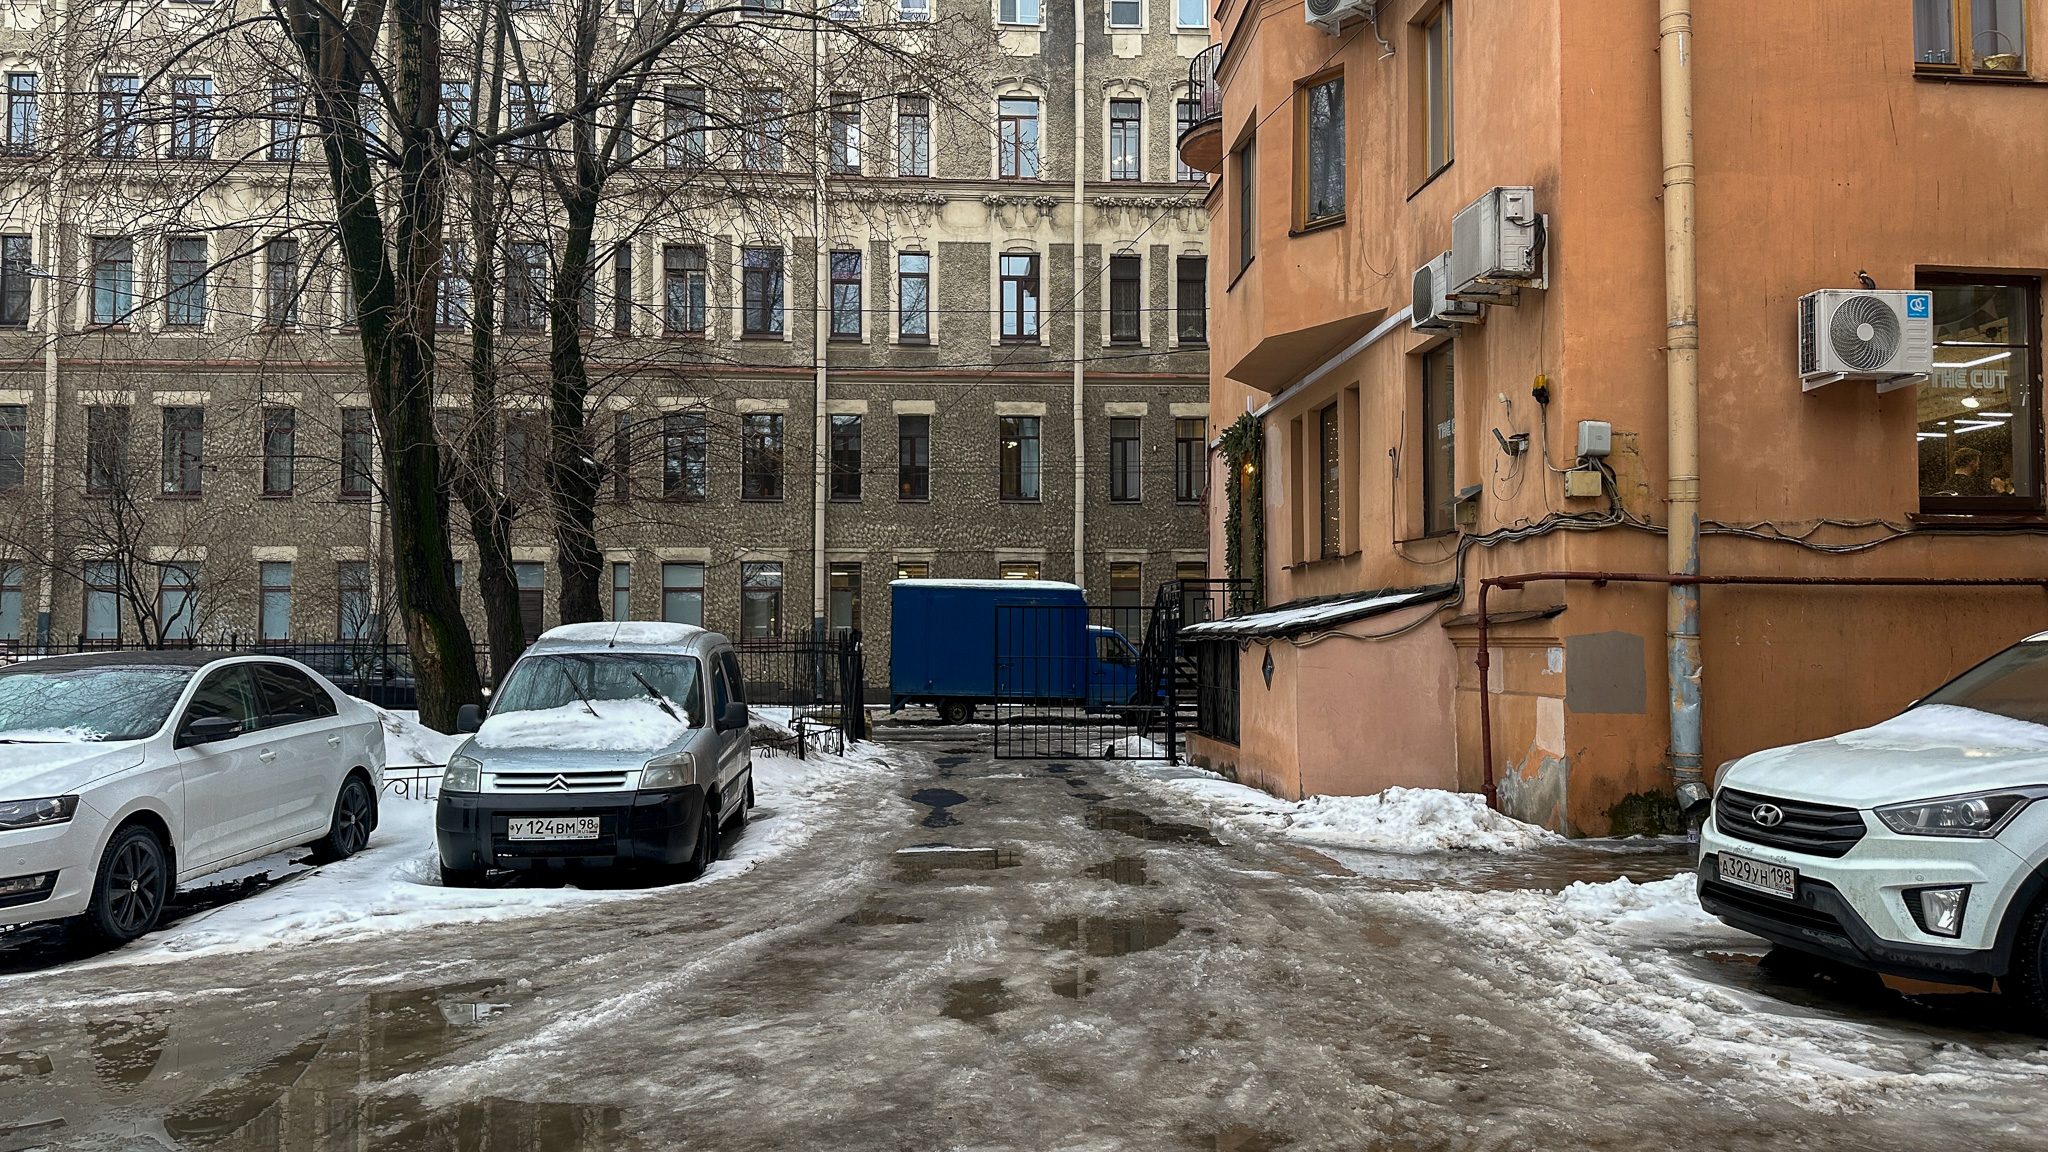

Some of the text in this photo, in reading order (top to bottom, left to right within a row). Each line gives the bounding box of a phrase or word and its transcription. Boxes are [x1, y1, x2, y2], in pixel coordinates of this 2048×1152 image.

[1932, 368, 2008, 389] THE CUT
[1437, 420, 1451, 440] THE
[579, 819, 594, 830] 98
[1770, 867, 1791, 885] 198
